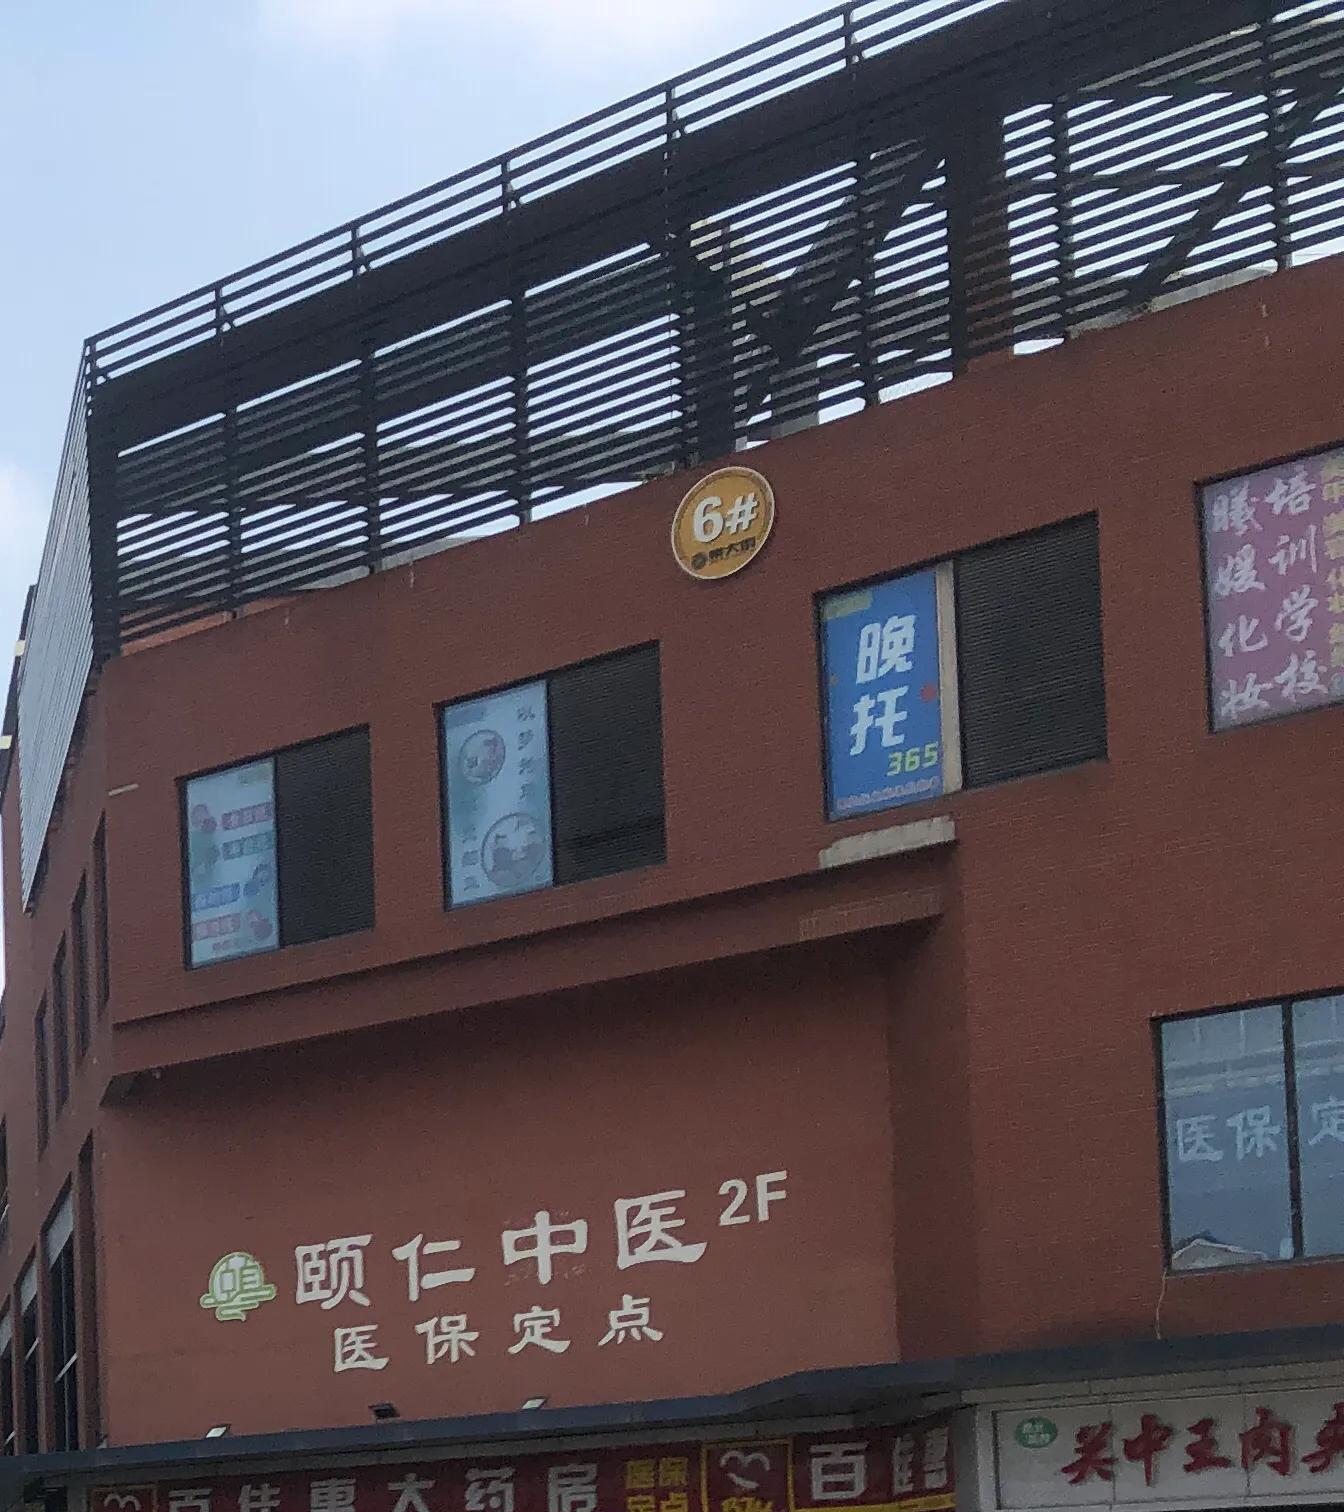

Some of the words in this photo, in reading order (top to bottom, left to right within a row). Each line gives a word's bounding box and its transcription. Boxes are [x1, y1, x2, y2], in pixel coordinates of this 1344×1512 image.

[693, 492, 759, 543] 6#
[1264, 464, 1329, 703] 培训学校
[850, 614, 917, 756] 晚托
[886, 741, 940, 777] 365
[293, 1189, 707, 1310] 颐仁中医
[718, 1170, 787, 1227] 2F
[333, 1294, 664, 1373] 医保定点
